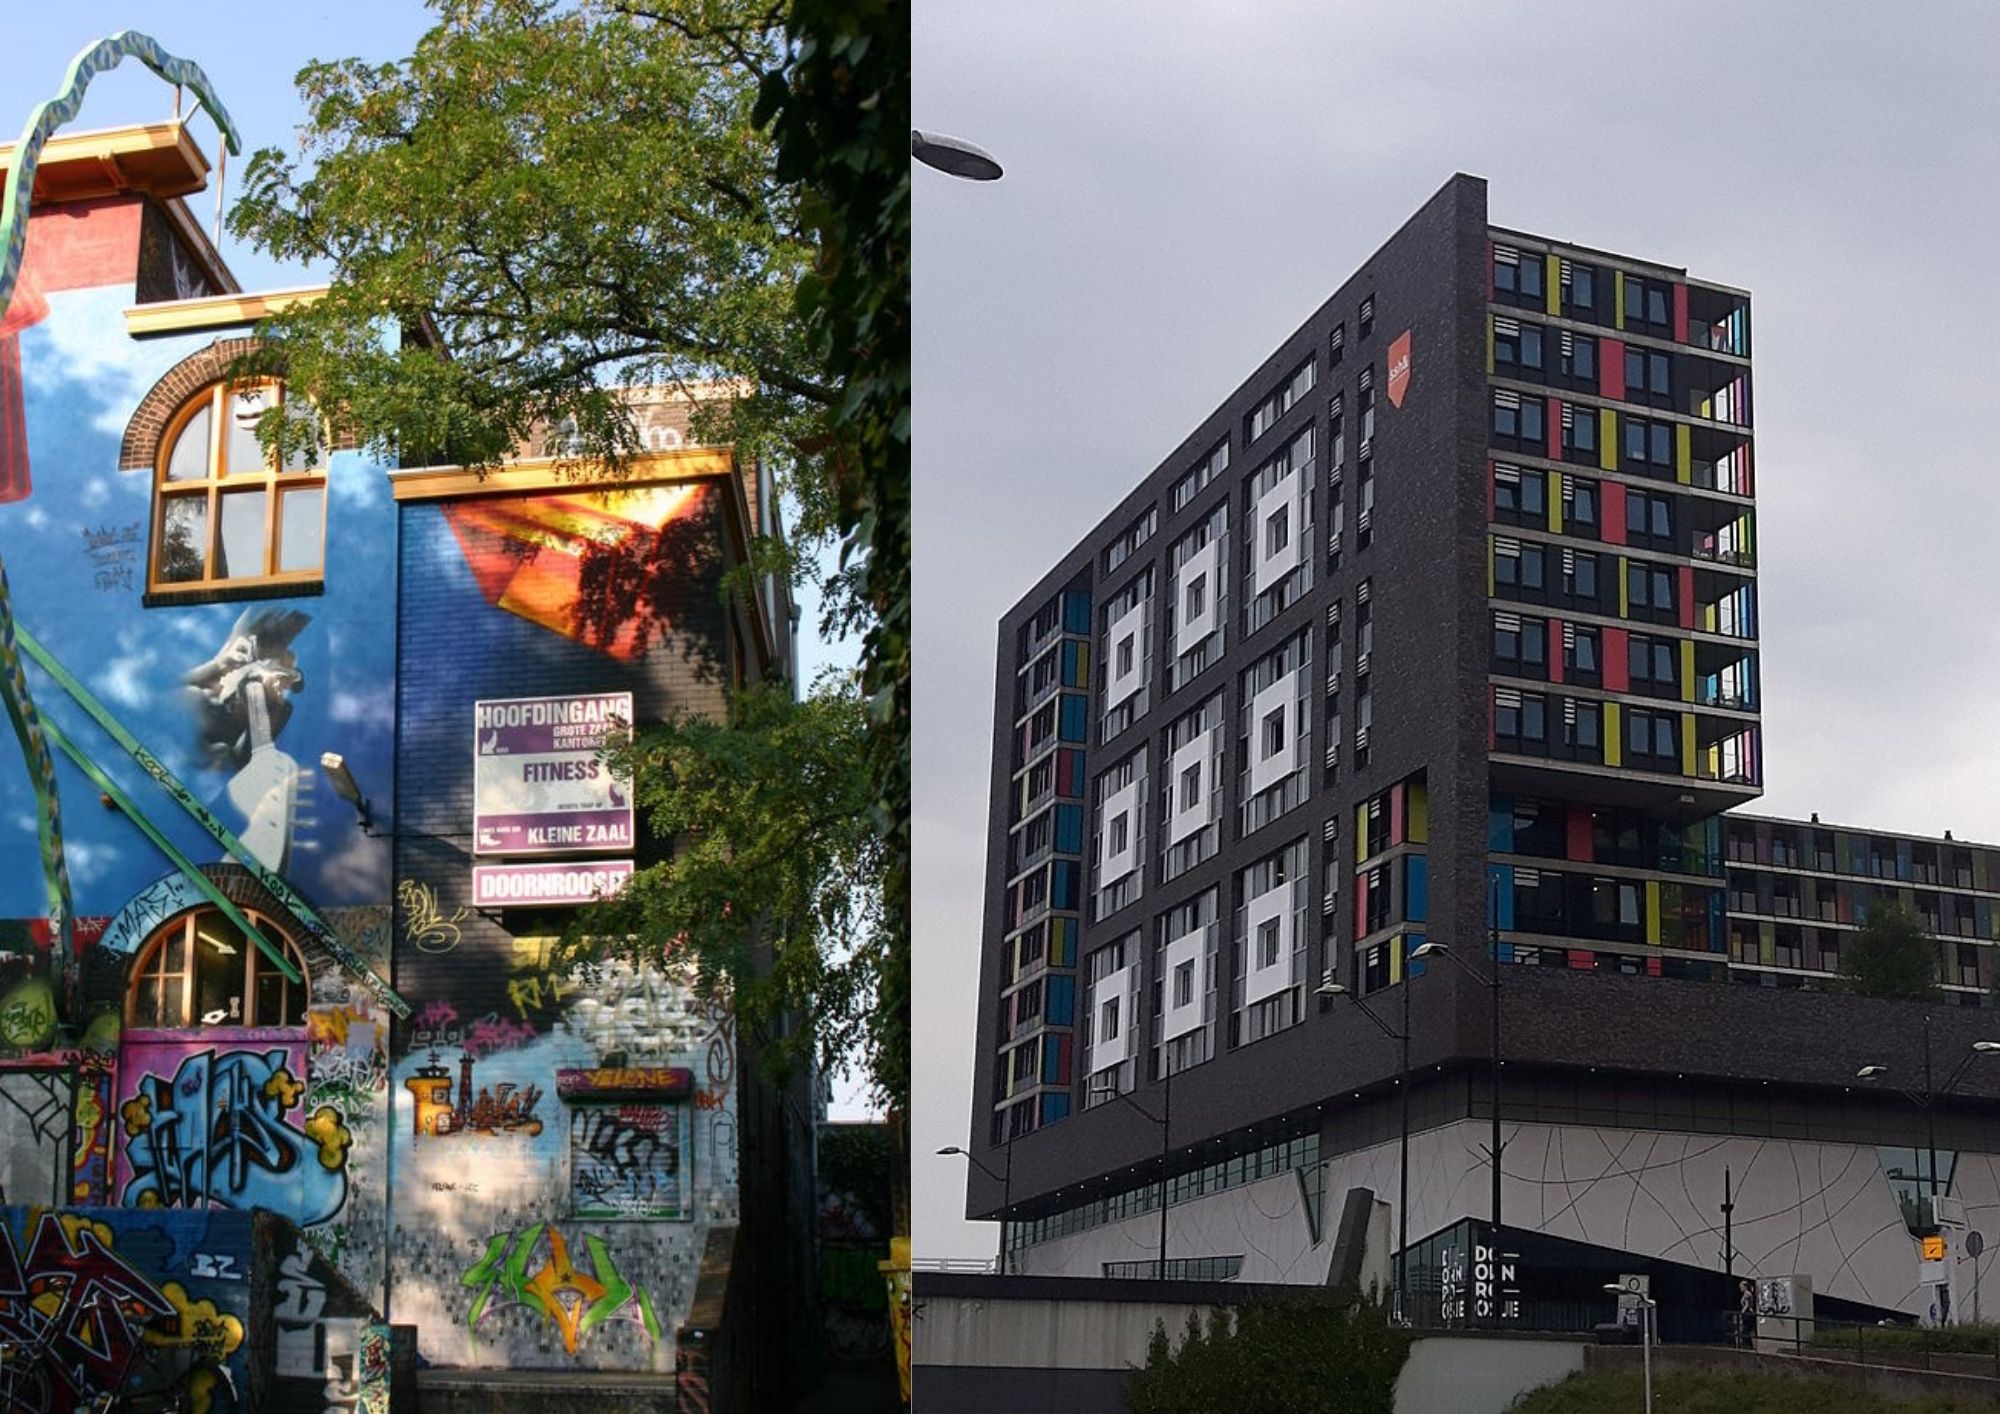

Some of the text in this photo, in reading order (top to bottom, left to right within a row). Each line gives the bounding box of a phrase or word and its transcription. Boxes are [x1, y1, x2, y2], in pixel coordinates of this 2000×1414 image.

[478, 698, 629, 728] HOOFDINGANG
[553, 724, 586, 737] GROTE
[523, 761, 599, 782] FITNESS
[527, 825, 582, 845] KLEINE
[586, 823, 628, 842] ZAAL
